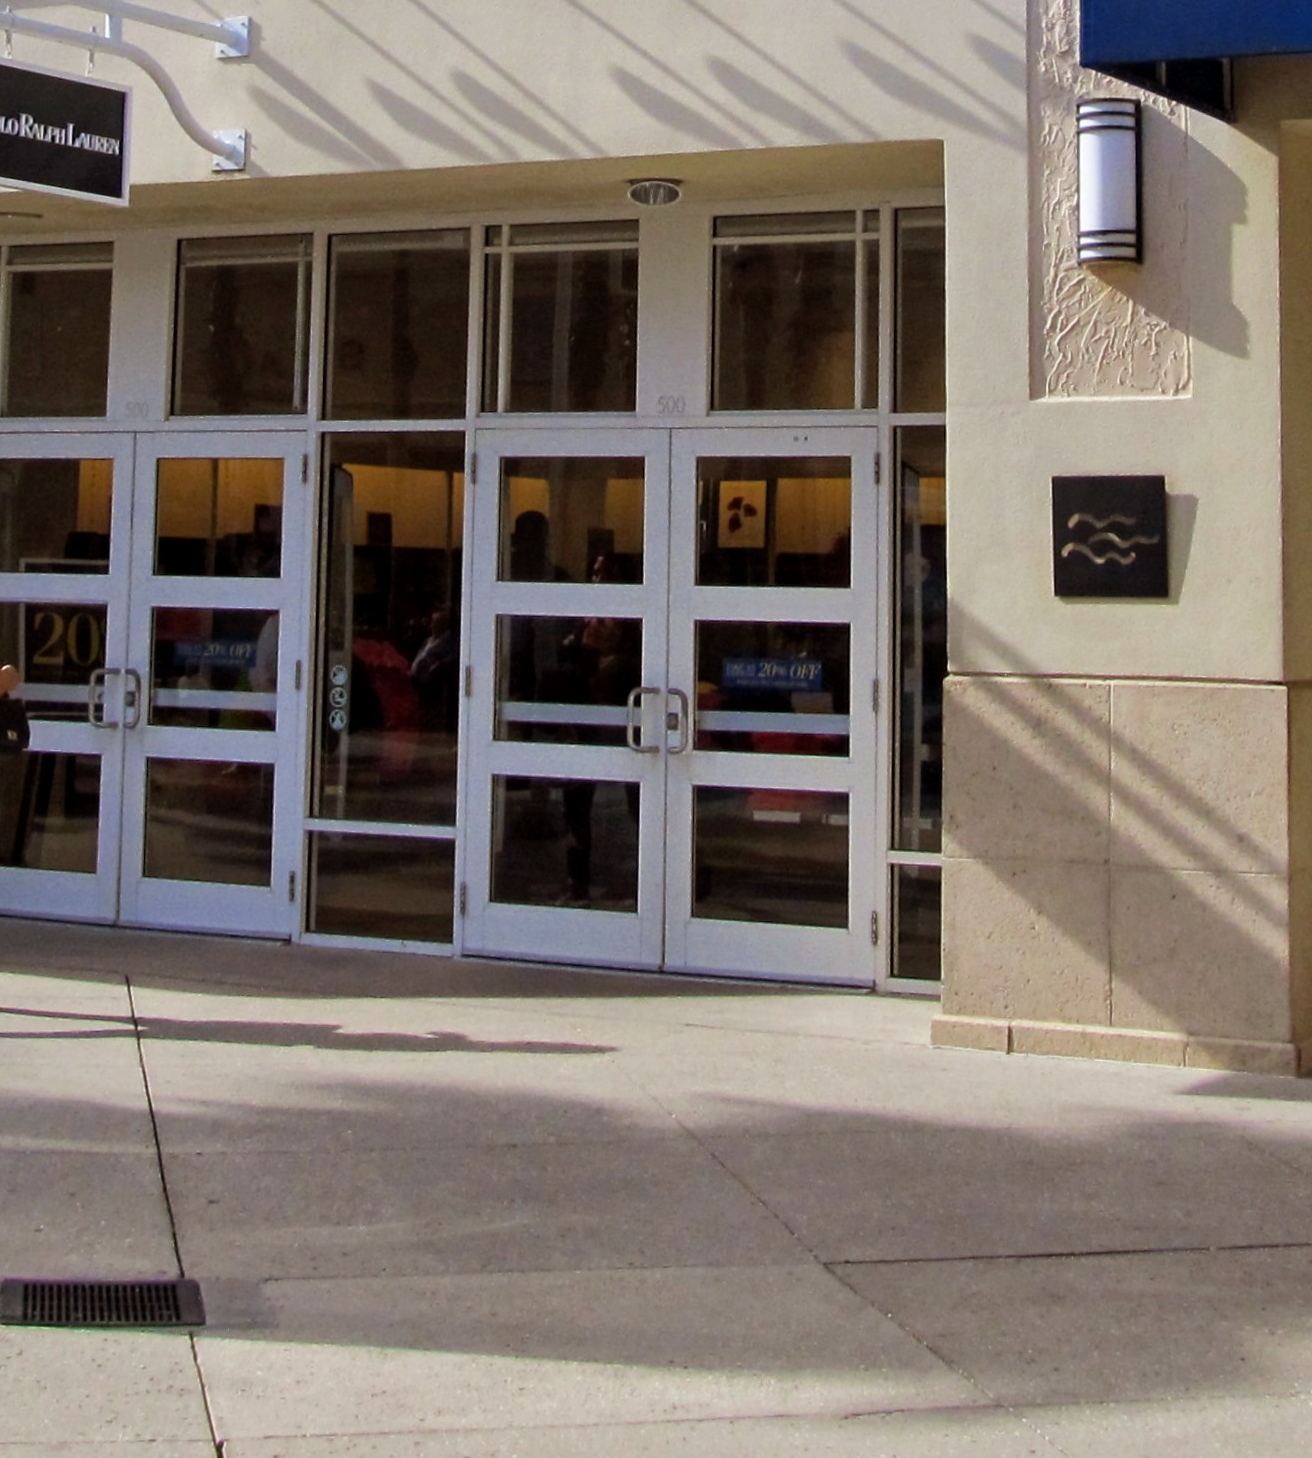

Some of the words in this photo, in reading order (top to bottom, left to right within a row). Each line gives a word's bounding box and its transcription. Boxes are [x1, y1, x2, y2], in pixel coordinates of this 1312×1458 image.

[18, 113, 66, 145] RALPH
[66, 122, 120, 156] LAUREN
[657, 395, 686, 415] 500
[32, 611, 105, 667] 20
